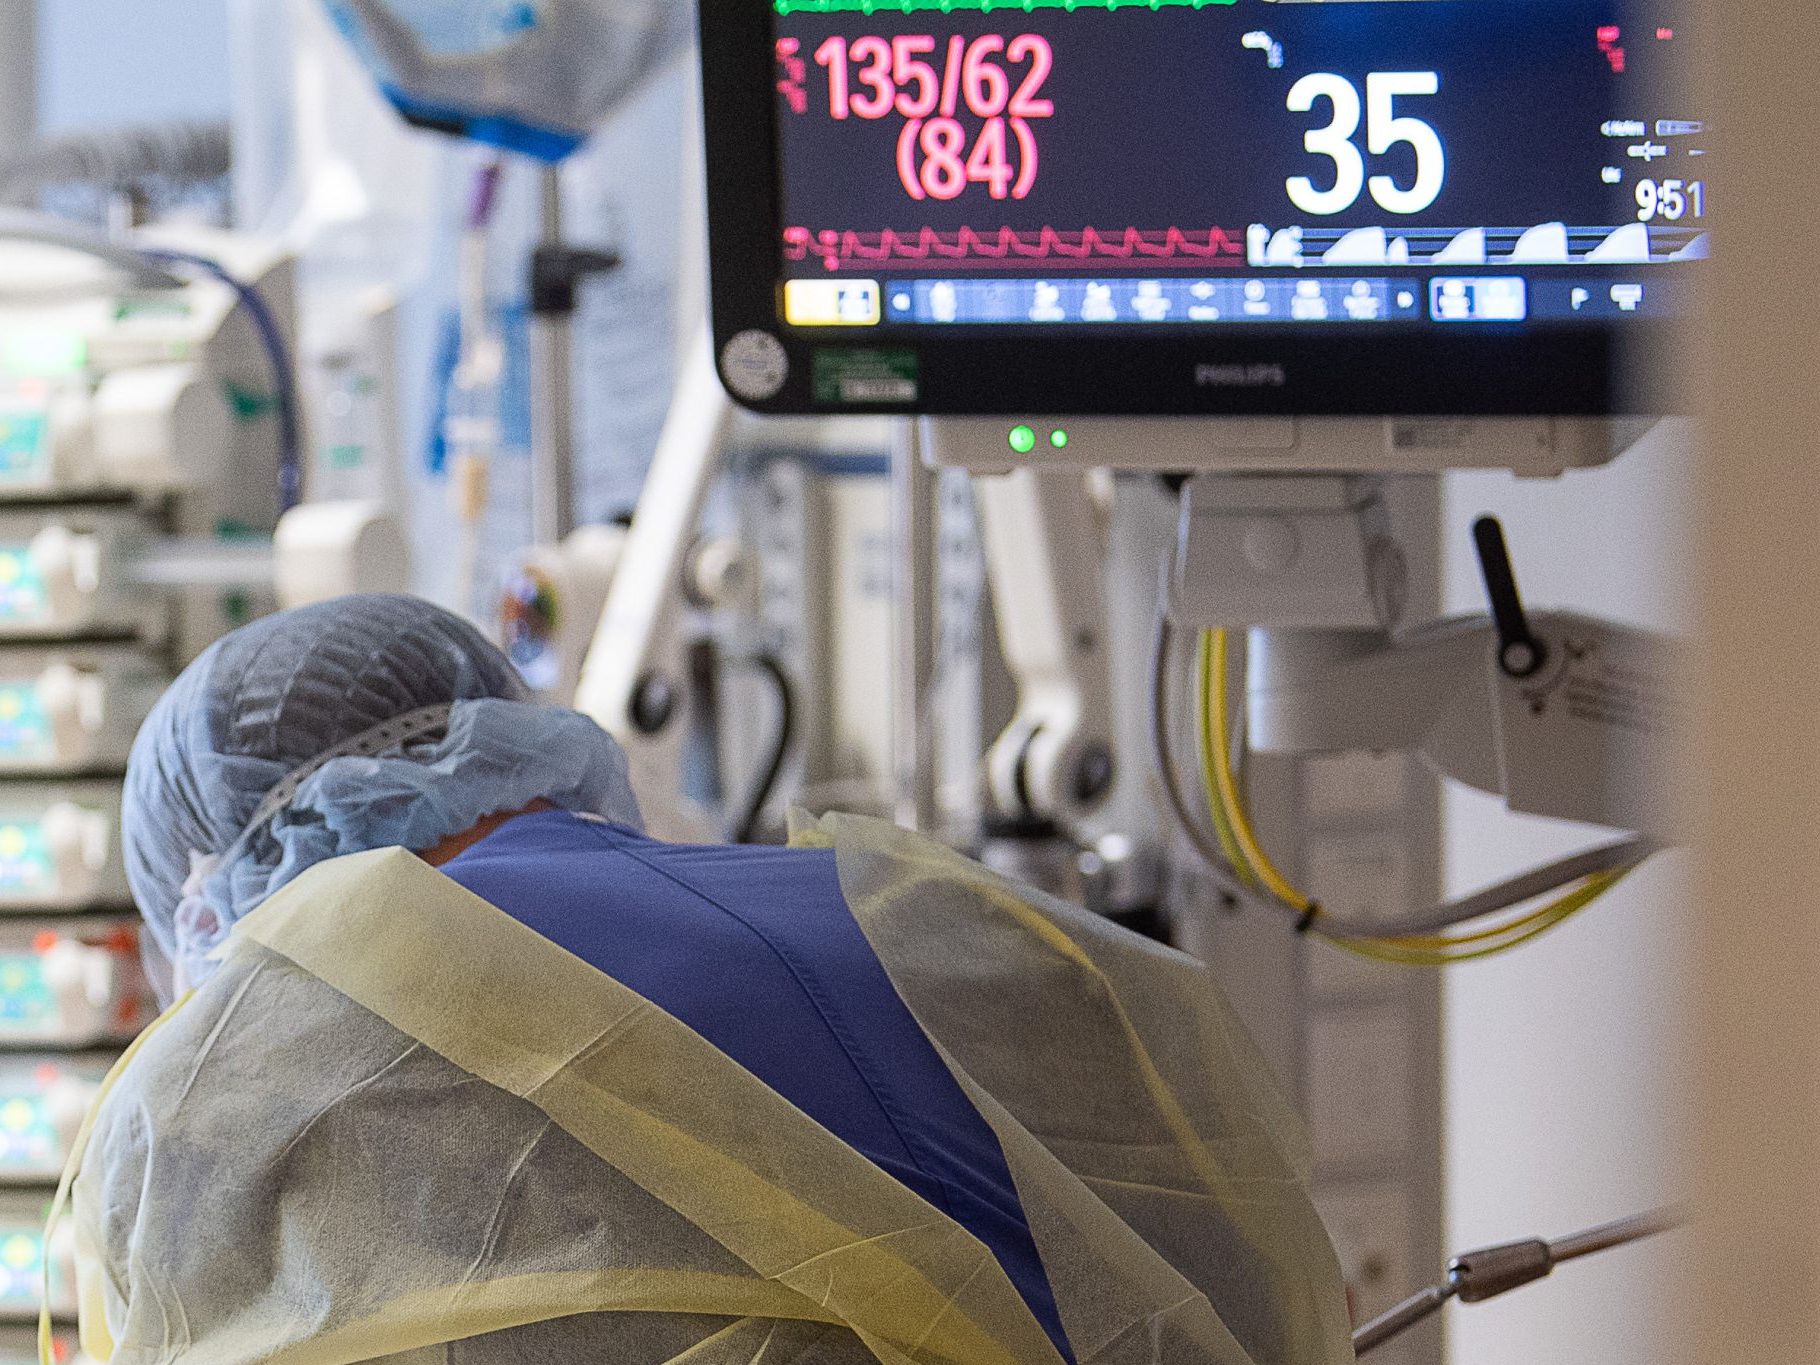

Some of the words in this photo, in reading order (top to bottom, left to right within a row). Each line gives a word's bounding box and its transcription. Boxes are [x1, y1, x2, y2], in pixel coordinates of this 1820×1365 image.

[814, 33, 1055, 120] 135/62
[896, 116, 1039, 200] (84)
[1286, 71, 1446, 215] 35
